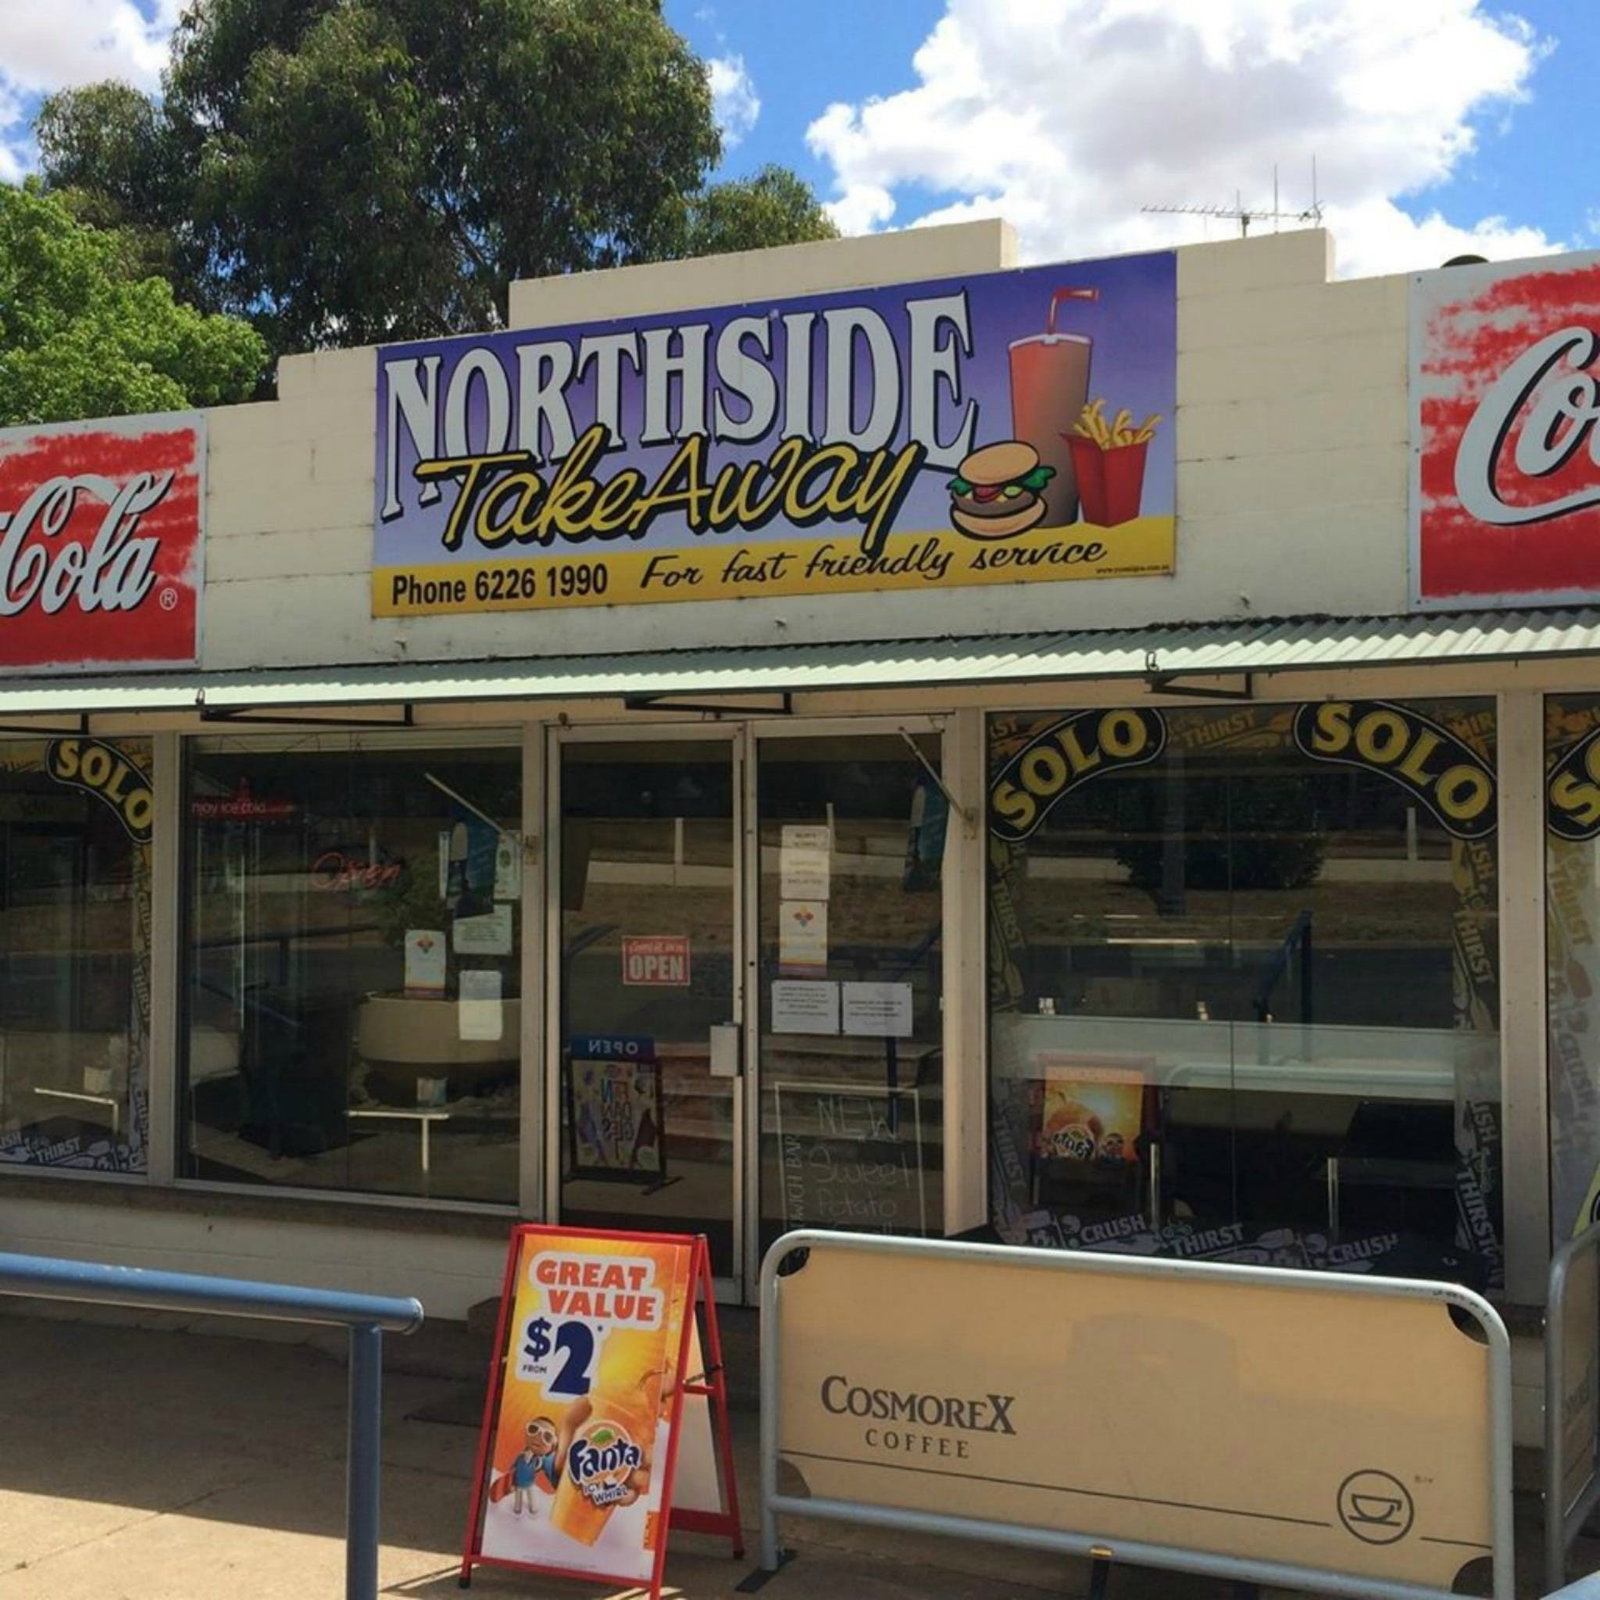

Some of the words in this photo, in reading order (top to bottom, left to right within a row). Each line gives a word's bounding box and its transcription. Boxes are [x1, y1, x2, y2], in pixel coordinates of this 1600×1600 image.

[380, 291, 979, 522] NORTHSIDE
[1454, 325, 1600, 526] Co
[640, 555, 703, 590] For
[722, 550, 788, 585] fast
[806, 535, 953, 582] friendly
[969, 538, 1108, 568] service
[392, 573, 467, 607] Phone
[474, 567, 536, 602] 6226
[546, 562, 608, 597] 1990
[1181, 710, 1255, 748] THIRST
[991, 708, 1148, 832] SOLO
[1311, 701, 1492, 820] SOLO
[56, 739, 153, 829] SOLO
[629, 955, 684, 981] OPEN
[817, 1096, 899, 1142] NEW
[1080, 1214, 1146, 1243] CRUSH
[1171, 1222, 1244, 1256] THIRST
[1328, 1232, 1399, 1264] CRUSH
[536, 1260, 647, 1290] GREAT
[548, 1290, 656, 1321] VALUE
[522, 1364, 548, 1375] FROM
[569, 1438, 640, 1482] Fanta
[864, 1427, 970, 1460] COFFEE
